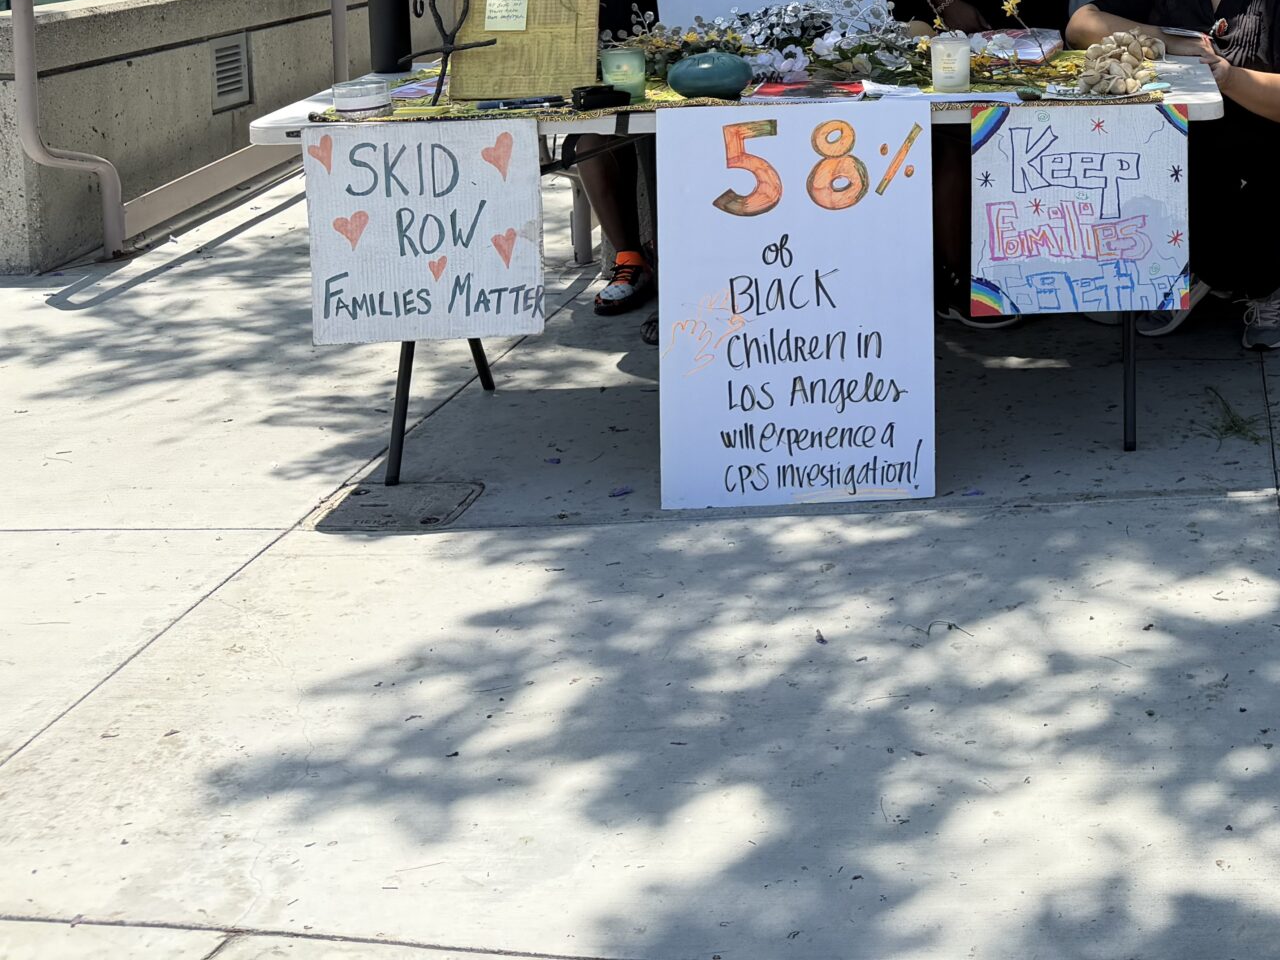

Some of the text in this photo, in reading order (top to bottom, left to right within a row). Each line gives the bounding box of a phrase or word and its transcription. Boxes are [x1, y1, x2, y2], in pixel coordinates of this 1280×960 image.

[345, 142, 460, 198] SKID
[712, 119, 923, 217] 58%
[395, 199, 487, 258] ROW
[761, 234, 794, 267] of
[856, 325, 883, 359] in
[789, 371, 909, 414] Angeles
[720, 421, 757, 451] will
[880, 420, 897, 449] a
[723, 463, 771, 496] CPS
